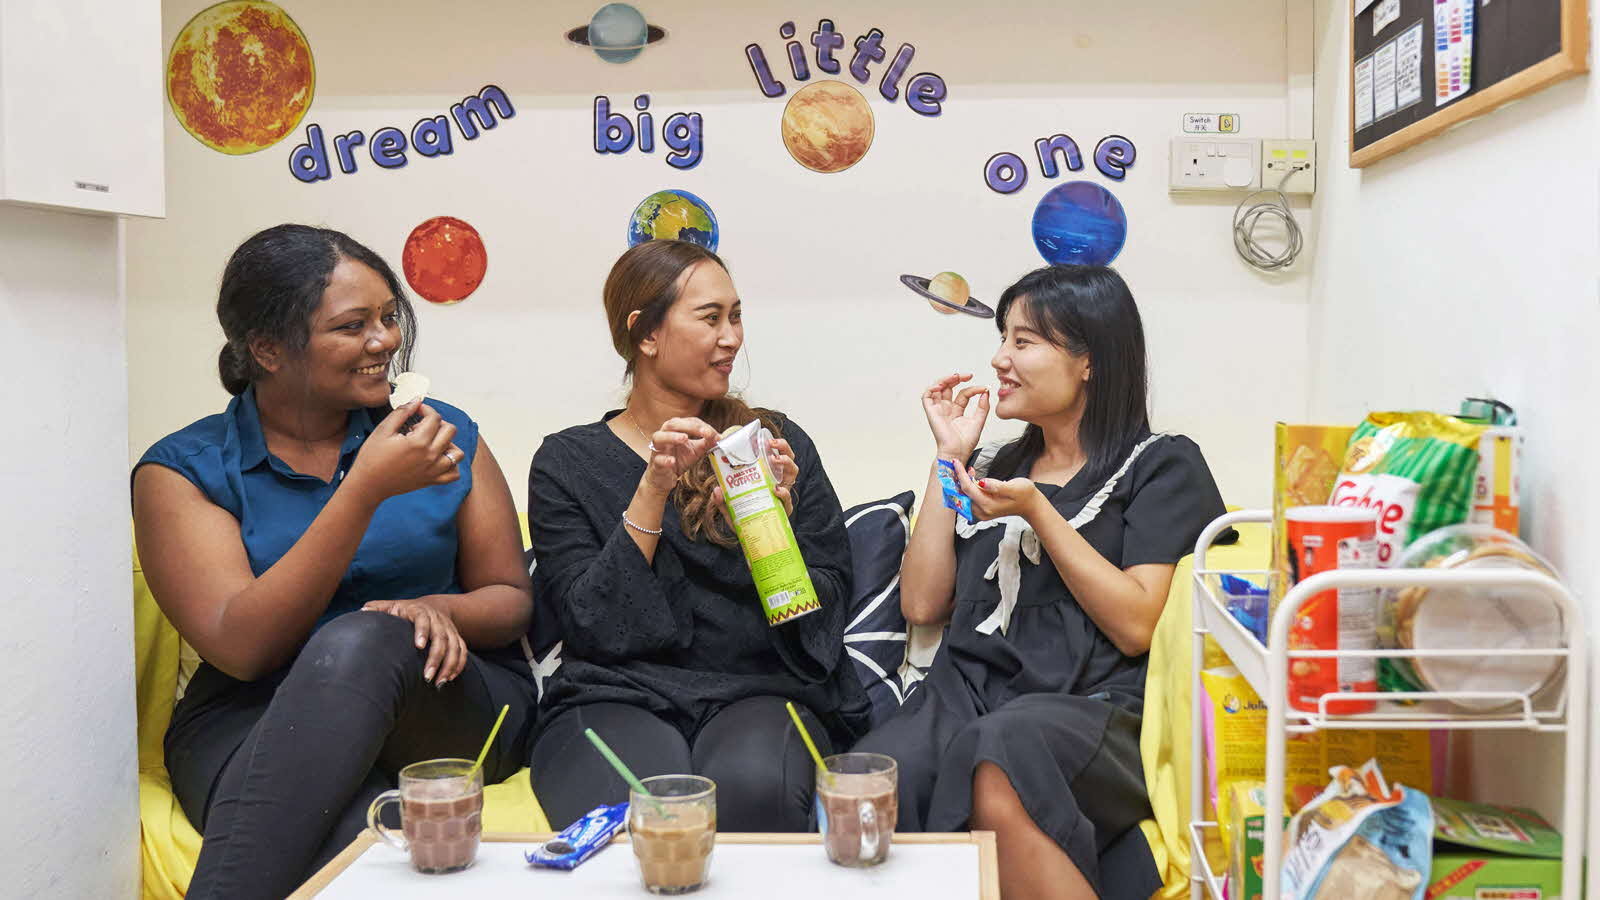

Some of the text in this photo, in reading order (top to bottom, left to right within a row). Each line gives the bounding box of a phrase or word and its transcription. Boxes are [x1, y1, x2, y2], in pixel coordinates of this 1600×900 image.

[289, 18, 1137, 194] dream big little one
[1189, 116, 1212, 124] Switch
[725, 471, 761, 489] POTATO
